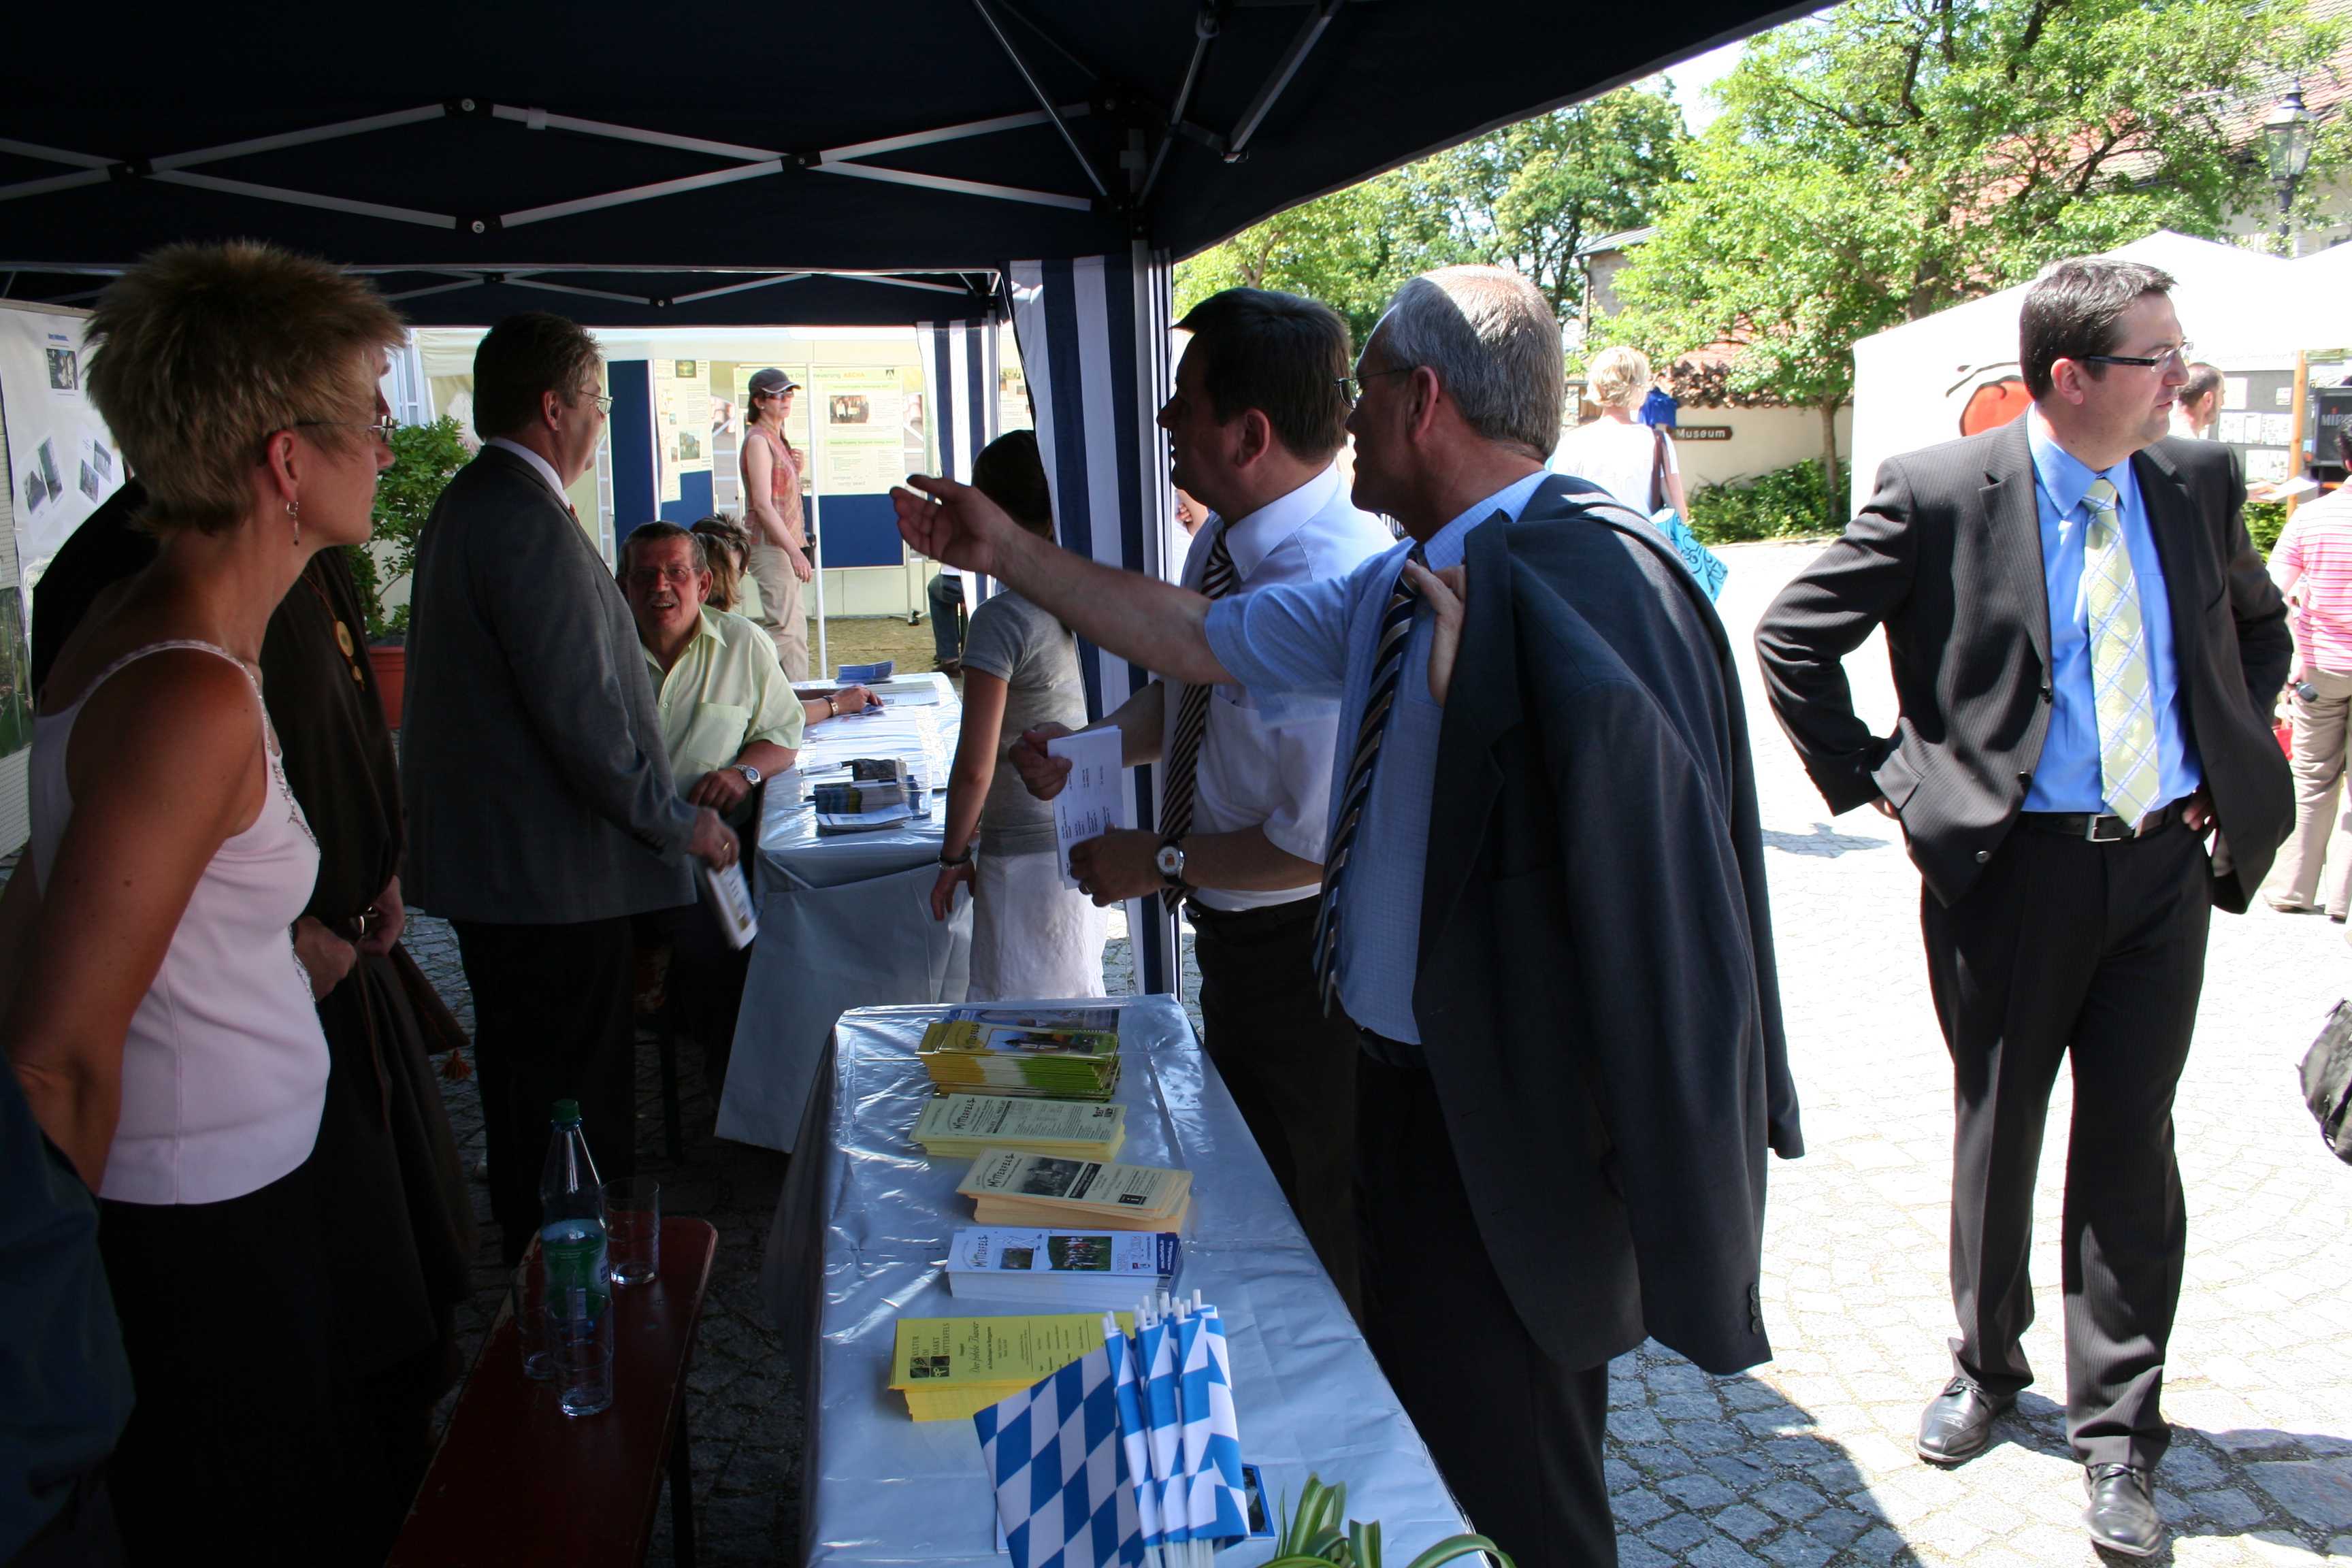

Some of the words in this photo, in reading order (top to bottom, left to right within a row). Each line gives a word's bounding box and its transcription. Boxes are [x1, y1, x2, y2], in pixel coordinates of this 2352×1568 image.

[1676, 429, 1725, 438] Museum
[953, 1097, 975, 1130] MITTERFELS
[985, 1152, 1015, 1188] MITTERFELS
[970, 1235, 988, 1268] MITTERFELS
[912, 1335, 920, 1356] KULTUR
[932, 1336, 941, 1356] MARKT
[942, 1322, 951, 1356] MITTERFELS
